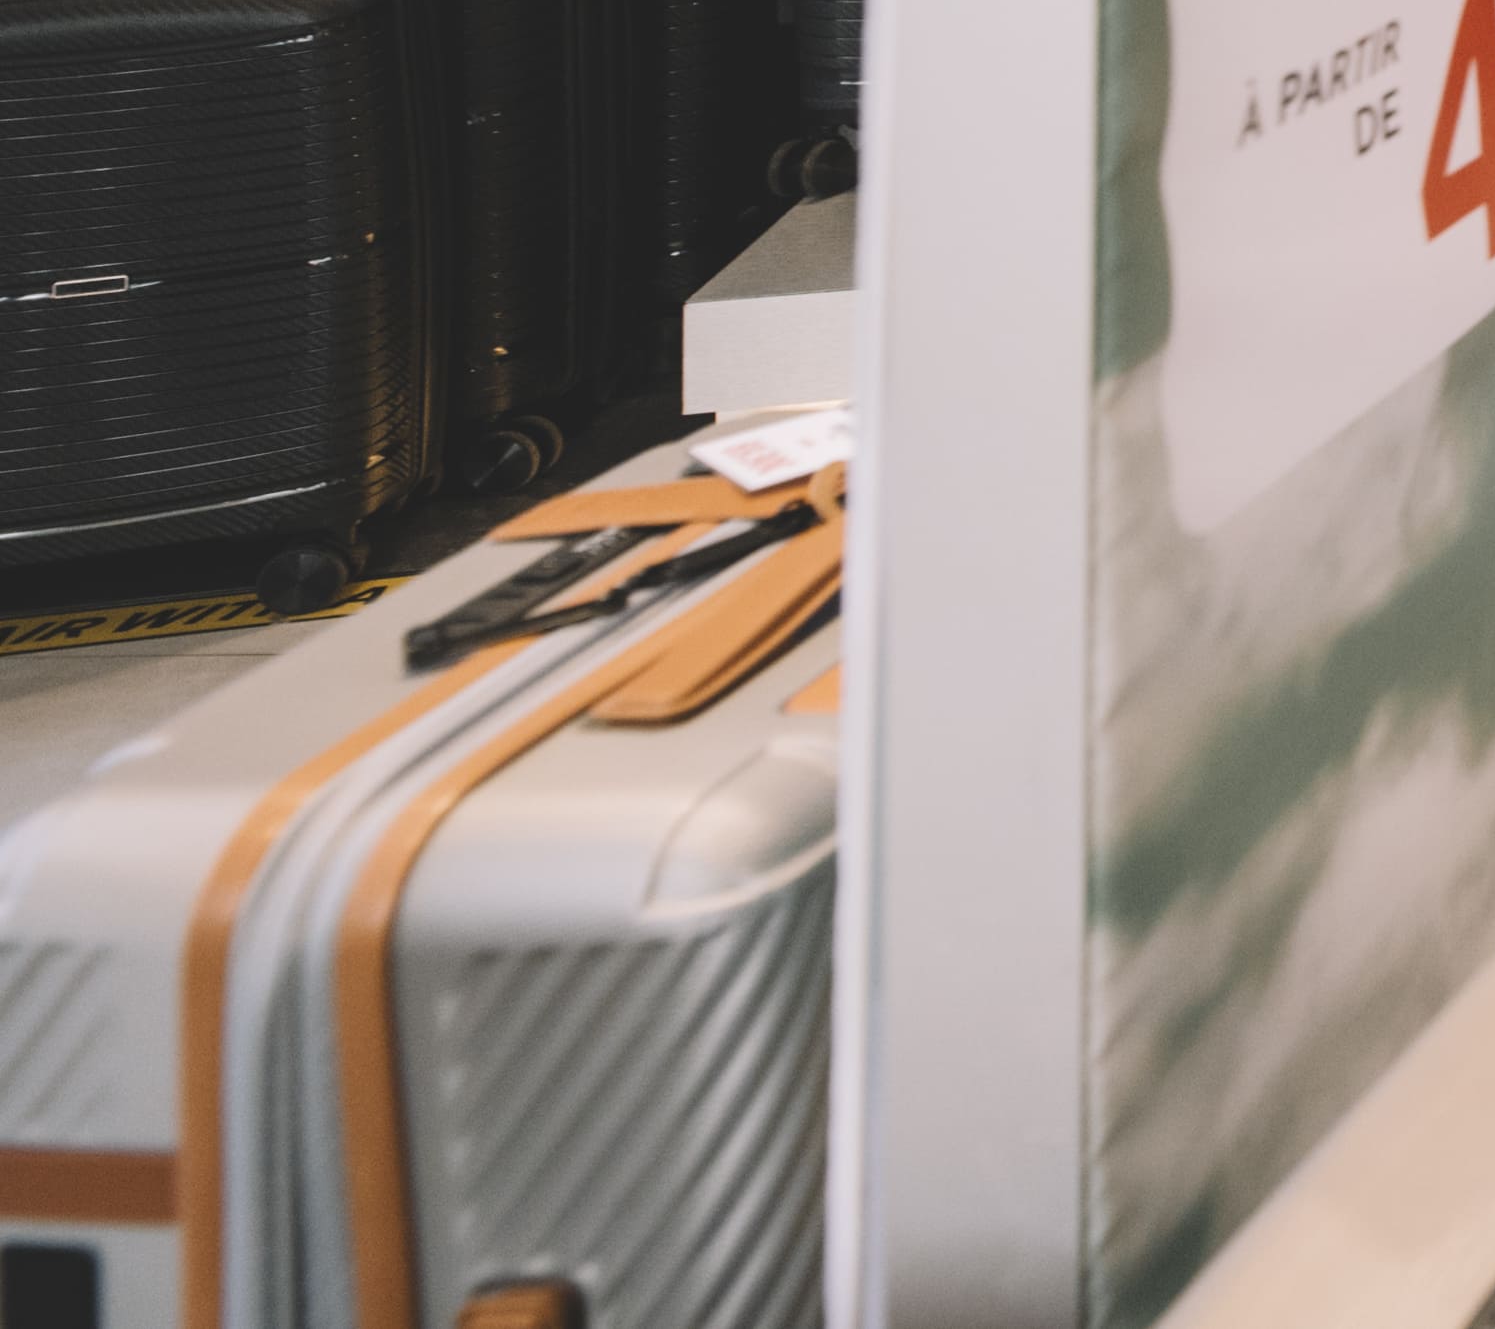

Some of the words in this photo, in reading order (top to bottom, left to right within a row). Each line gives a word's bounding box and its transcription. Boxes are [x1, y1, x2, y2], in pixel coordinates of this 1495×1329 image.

[1277, 19, 1401, 127] PARTIR
[1355, 88, 1401, 157] DE
[114, 599, 277, 632] WIT
